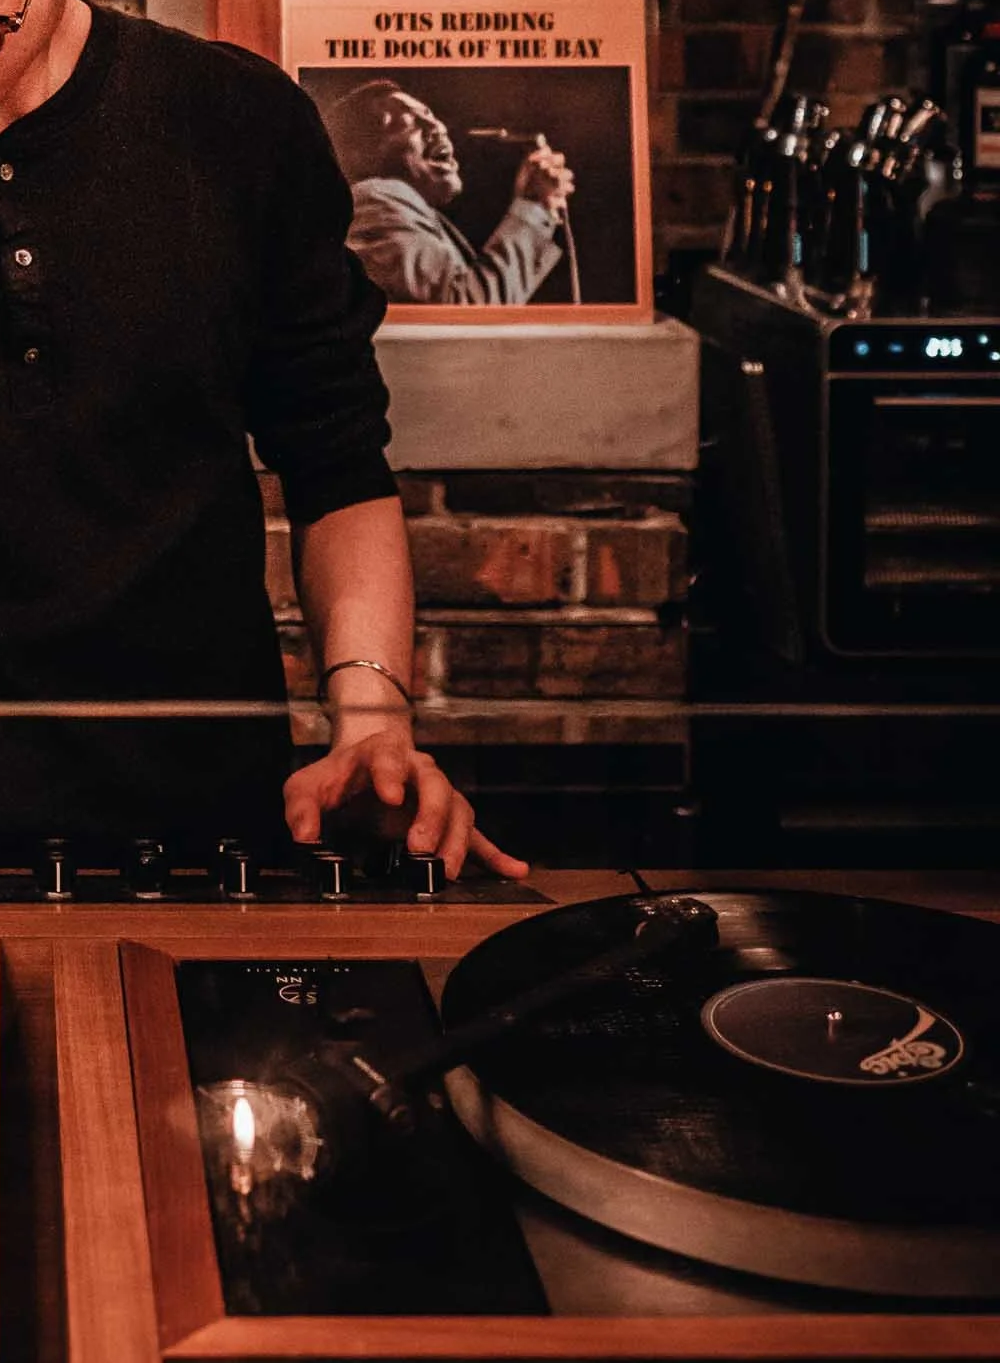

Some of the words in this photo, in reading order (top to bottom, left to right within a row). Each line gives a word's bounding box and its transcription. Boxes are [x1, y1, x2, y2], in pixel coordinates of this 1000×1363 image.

[374, 12, 433, 32] OTIS
[441, 12, 555, 32] REDDING
[325, 39, 377, 59] THE
[383, 39, 452, 59] DOCK
[458, 39, 491, 59] OF
[495, 39, 548, 59] THE
[554, 39, 603, 59] BAY
